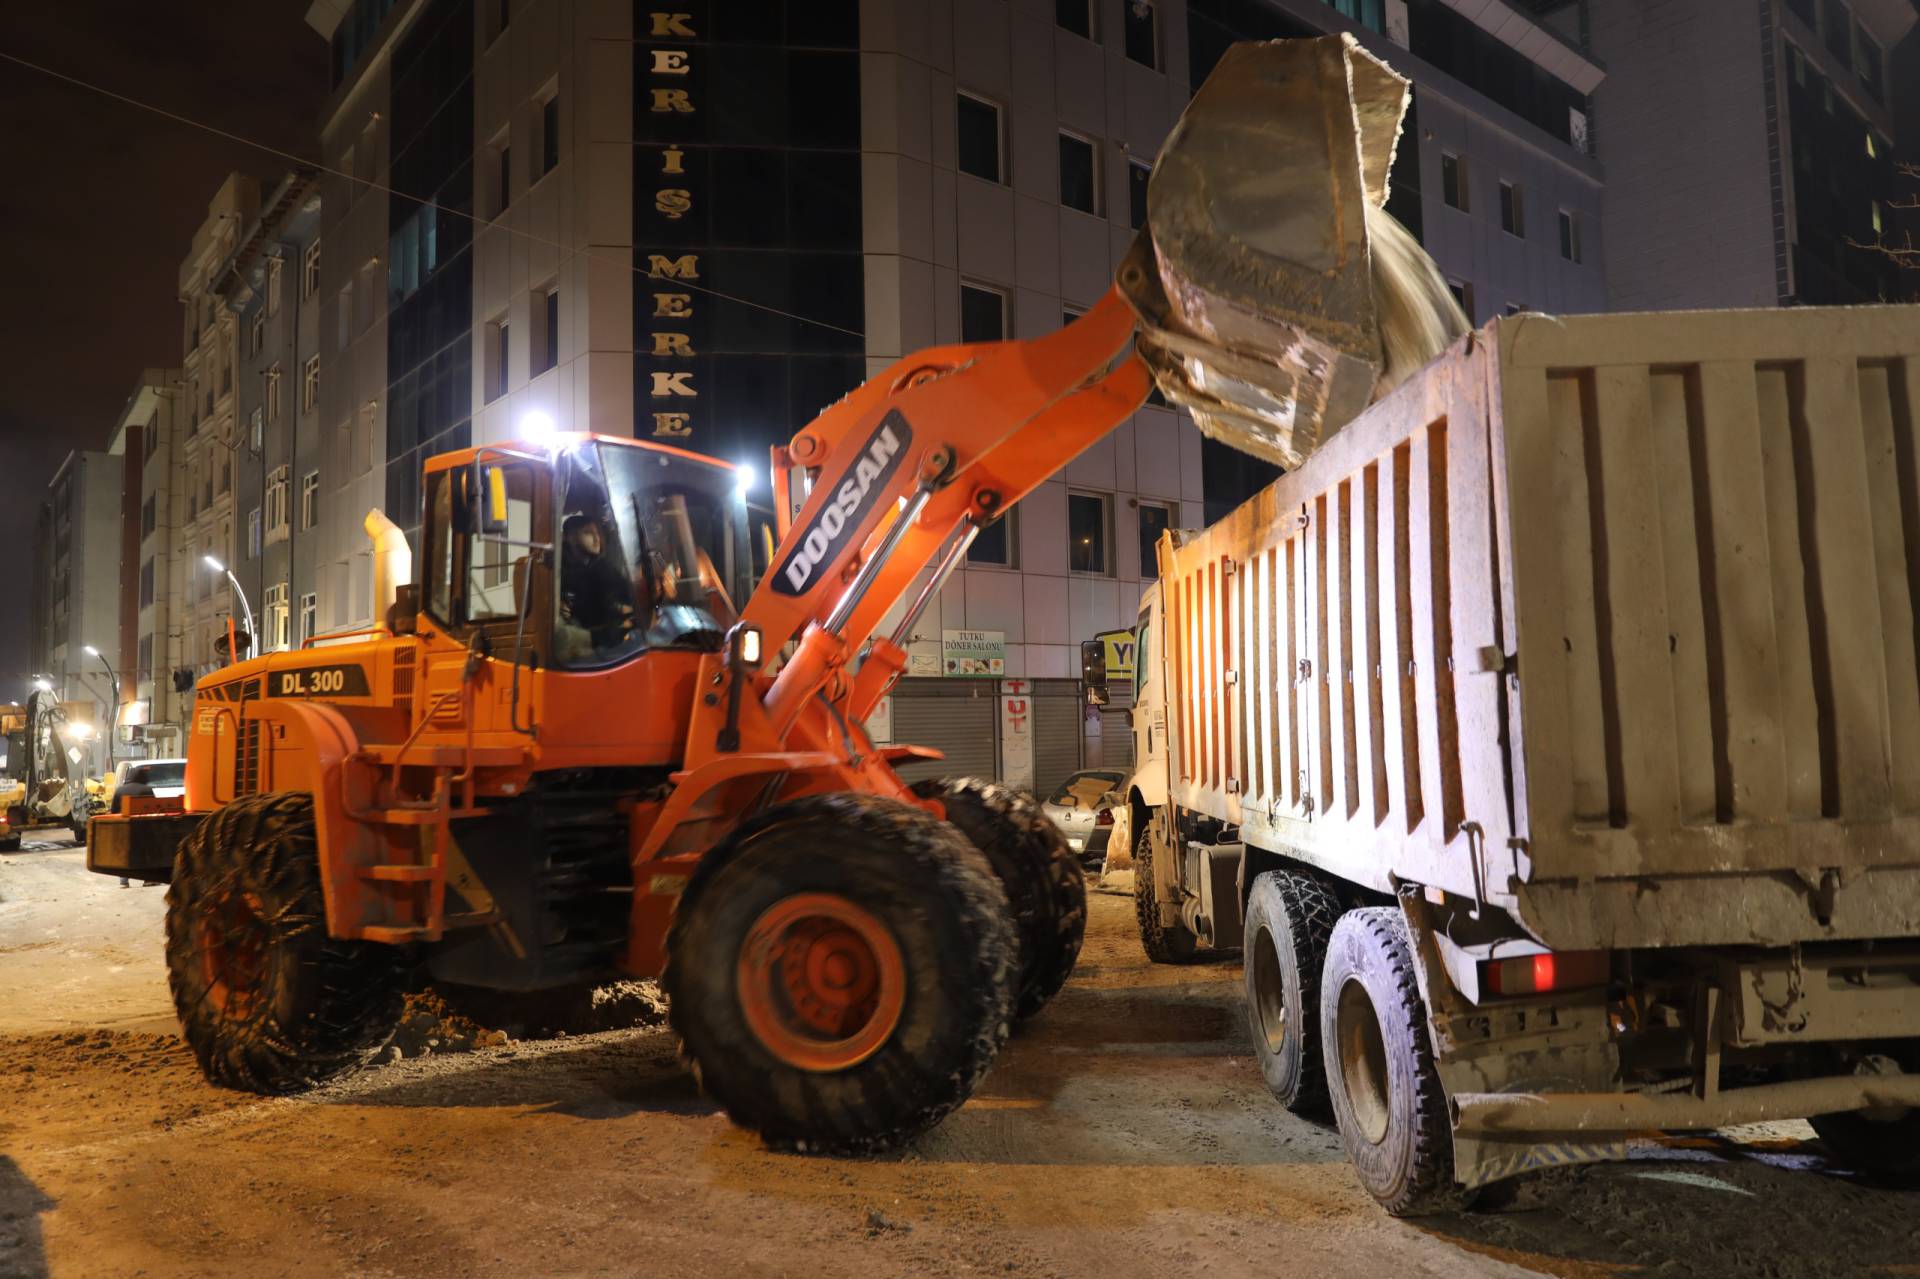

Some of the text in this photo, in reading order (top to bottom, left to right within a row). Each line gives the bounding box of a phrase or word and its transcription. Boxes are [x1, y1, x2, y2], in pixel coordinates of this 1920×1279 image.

[785, 424, 900, 592] DOOSAN
[945, 640, 972, 650] DÖNER
[959, 632, 985, 641] TUTKU
[282, 670, 344, 694] DL 300
